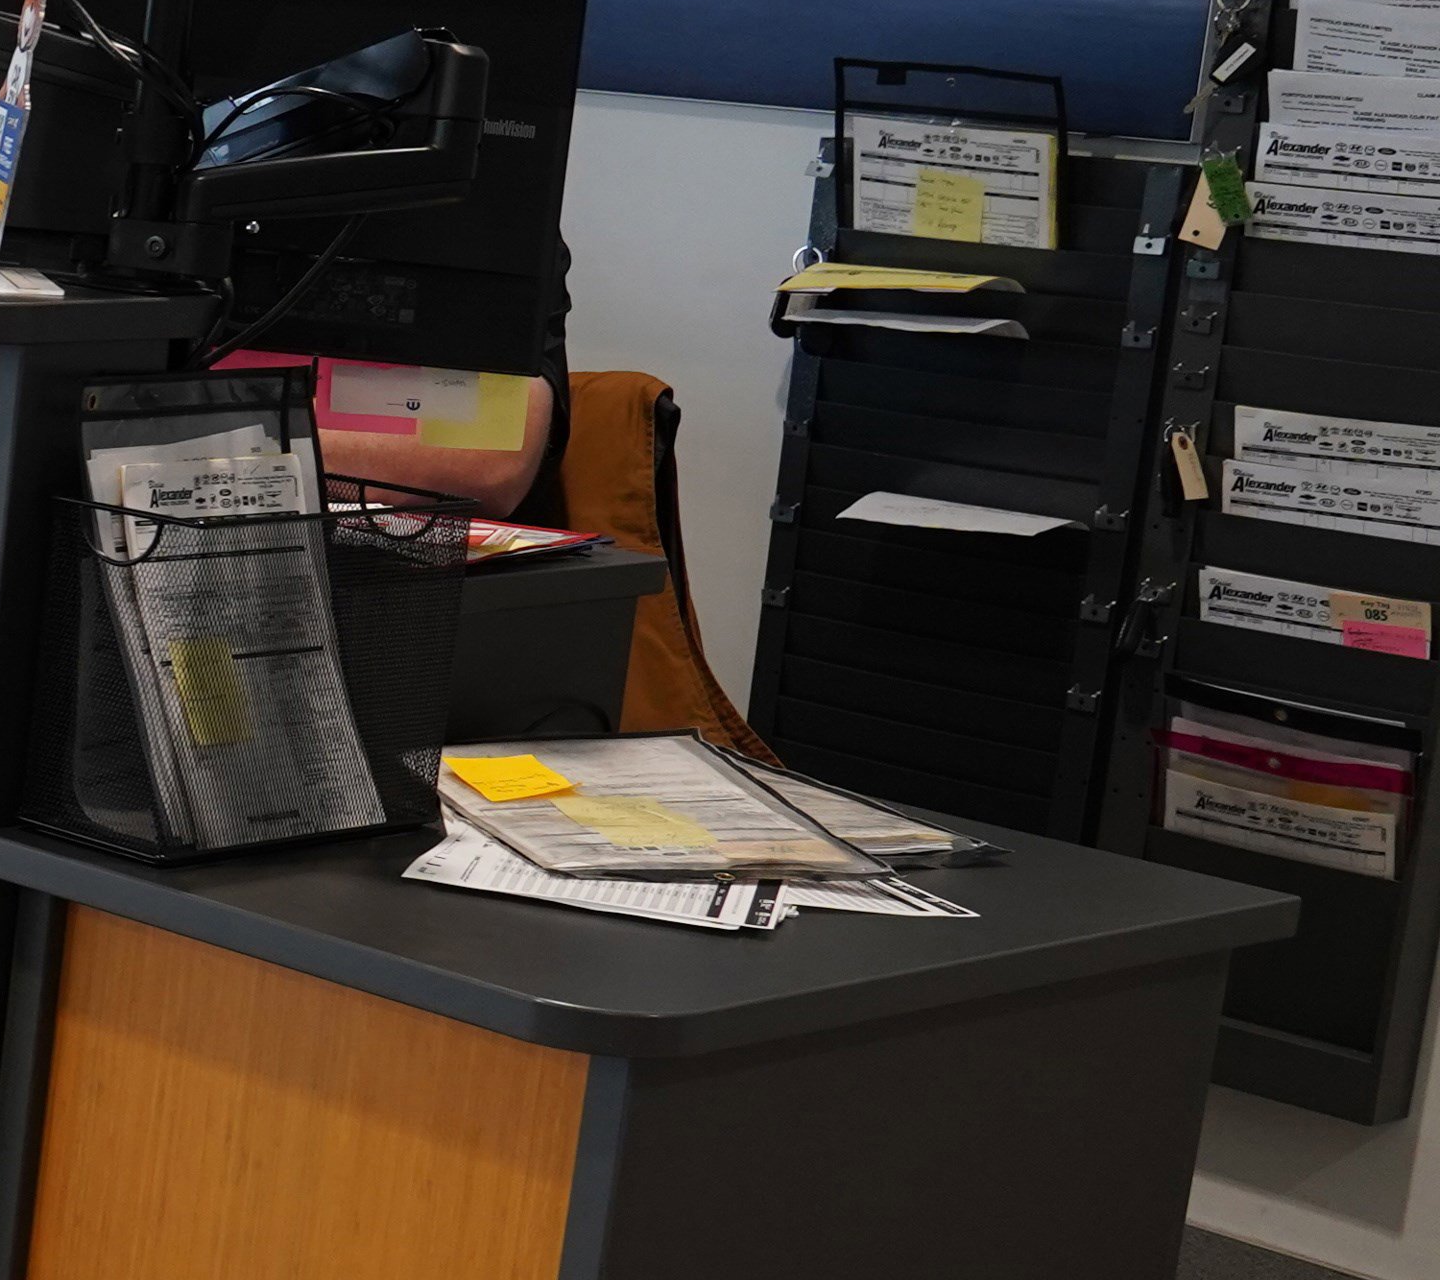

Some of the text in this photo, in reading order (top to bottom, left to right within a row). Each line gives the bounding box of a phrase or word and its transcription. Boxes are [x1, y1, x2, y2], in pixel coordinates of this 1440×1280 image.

[483, 117, 536, 139] hinkVision
[878, 135, 922, 150] Alexander
[1266, 139, 1332, 157] Alexander
[1253, 199, 1319, 216] Alexander
[1263, 427, 1318, 443] Alexander
[1230, 475, 1297, 495] Alexander
[149, 487, 194, 509] Alexander
[1208, 585, 1275, 603] Alexander
[1364, 608, 1389, 622] 085
